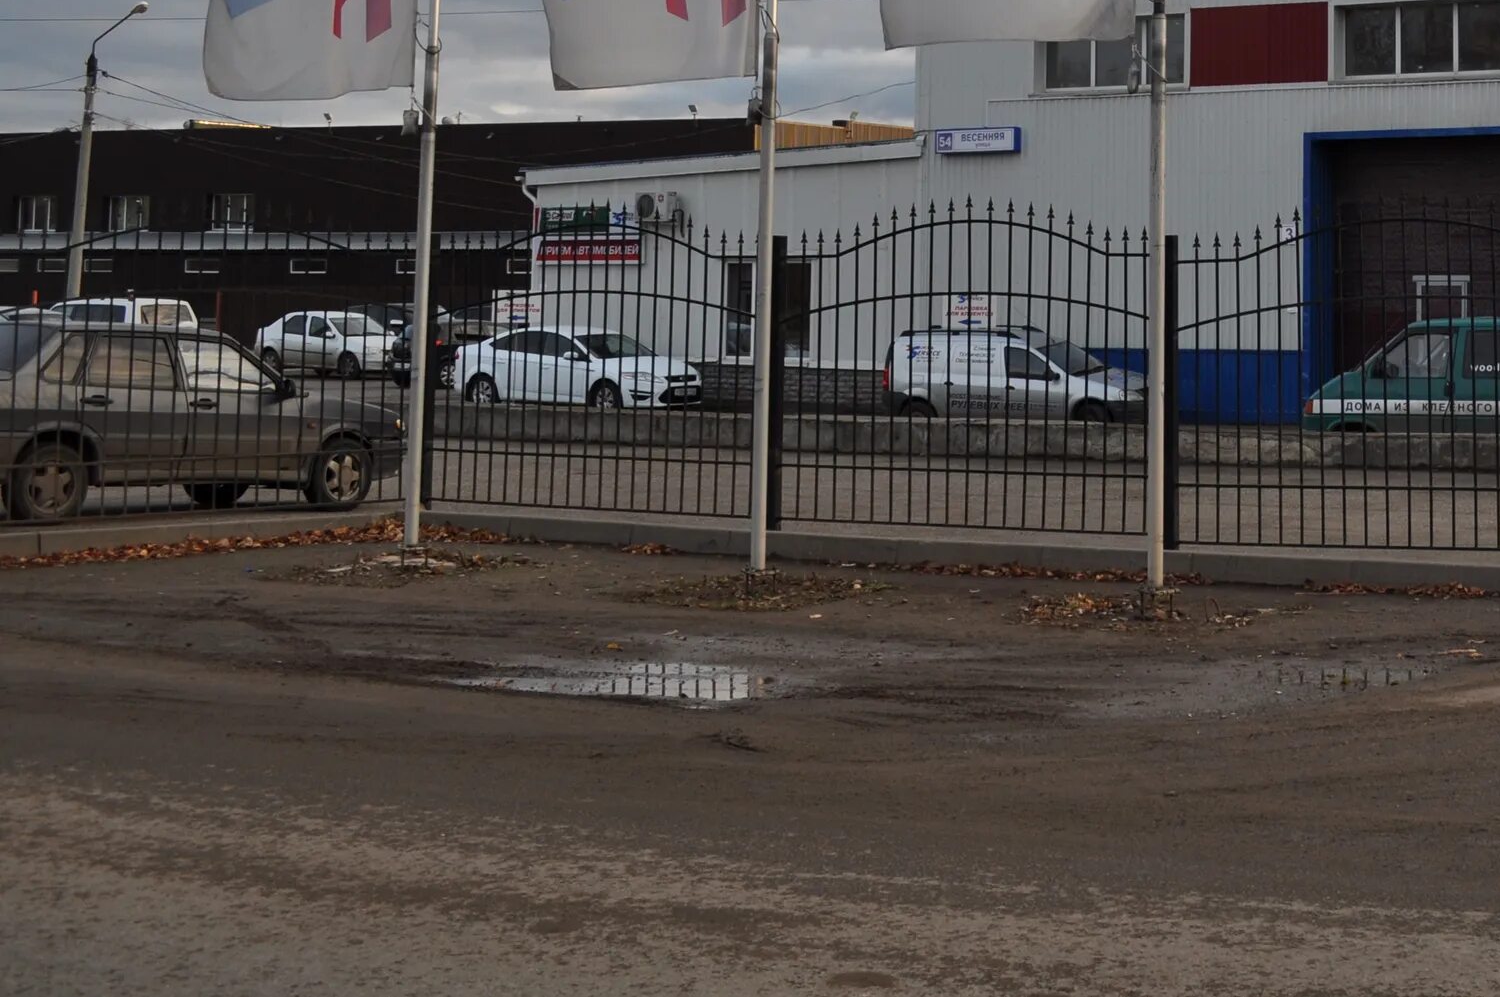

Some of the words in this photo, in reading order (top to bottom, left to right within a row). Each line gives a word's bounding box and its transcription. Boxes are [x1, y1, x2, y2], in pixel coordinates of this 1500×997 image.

[939, 136, 952, 148] 54
[961, 132, 1005, 142] ВЕСЕННЯЯ
[1286, 228, 1294, 241] 3
[1345, 402, 1382, 412] ДОМА
[1394, 402, 1408, 412] ИЗ
